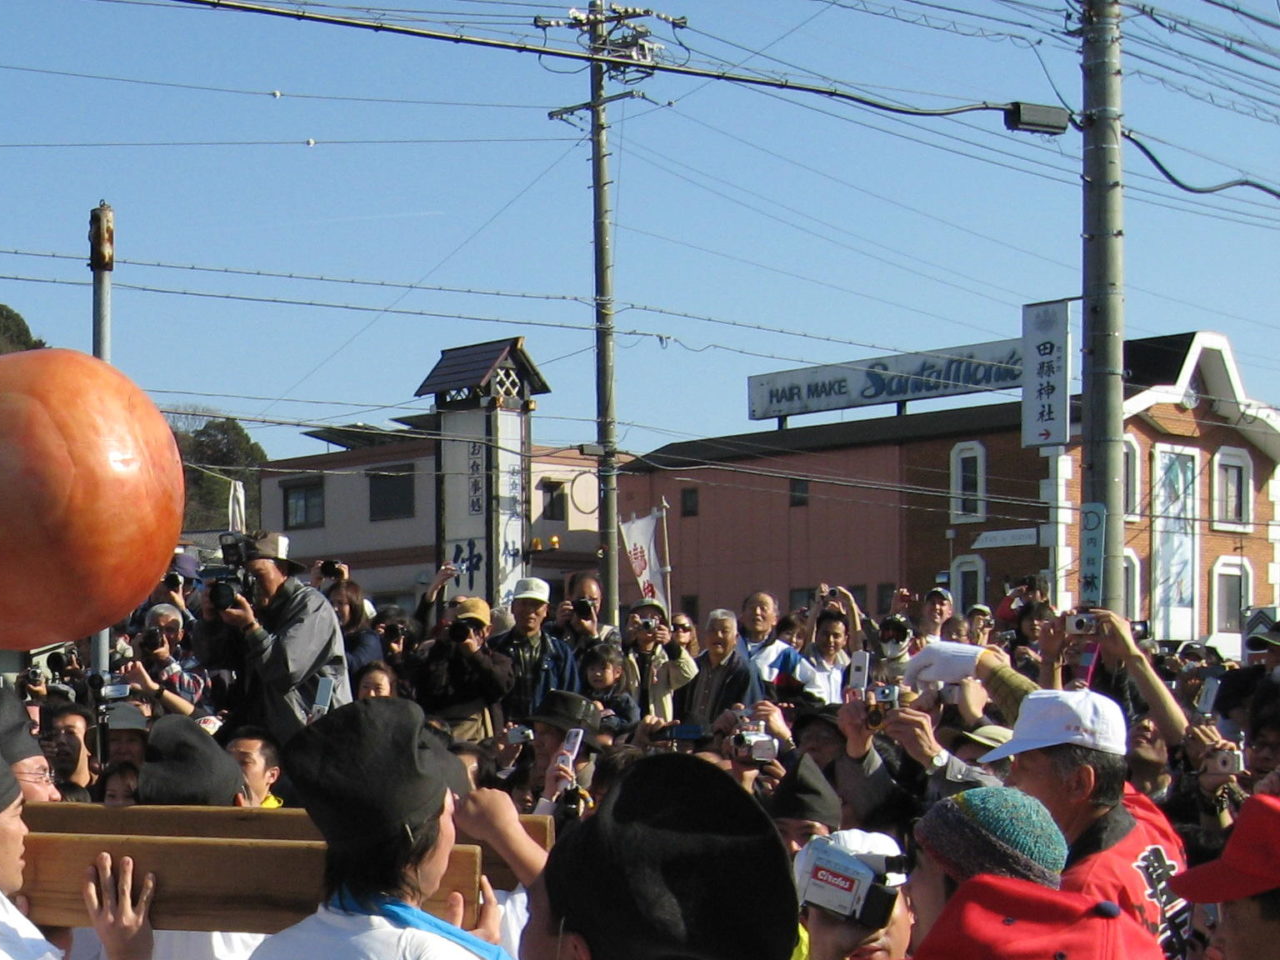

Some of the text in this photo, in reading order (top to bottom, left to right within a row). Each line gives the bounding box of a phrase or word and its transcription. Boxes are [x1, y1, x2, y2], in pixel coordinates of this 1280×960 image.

[770, 379, 847, 404] HAIR MAKE
[1036, 340, 1056, 422] 田縣神社
